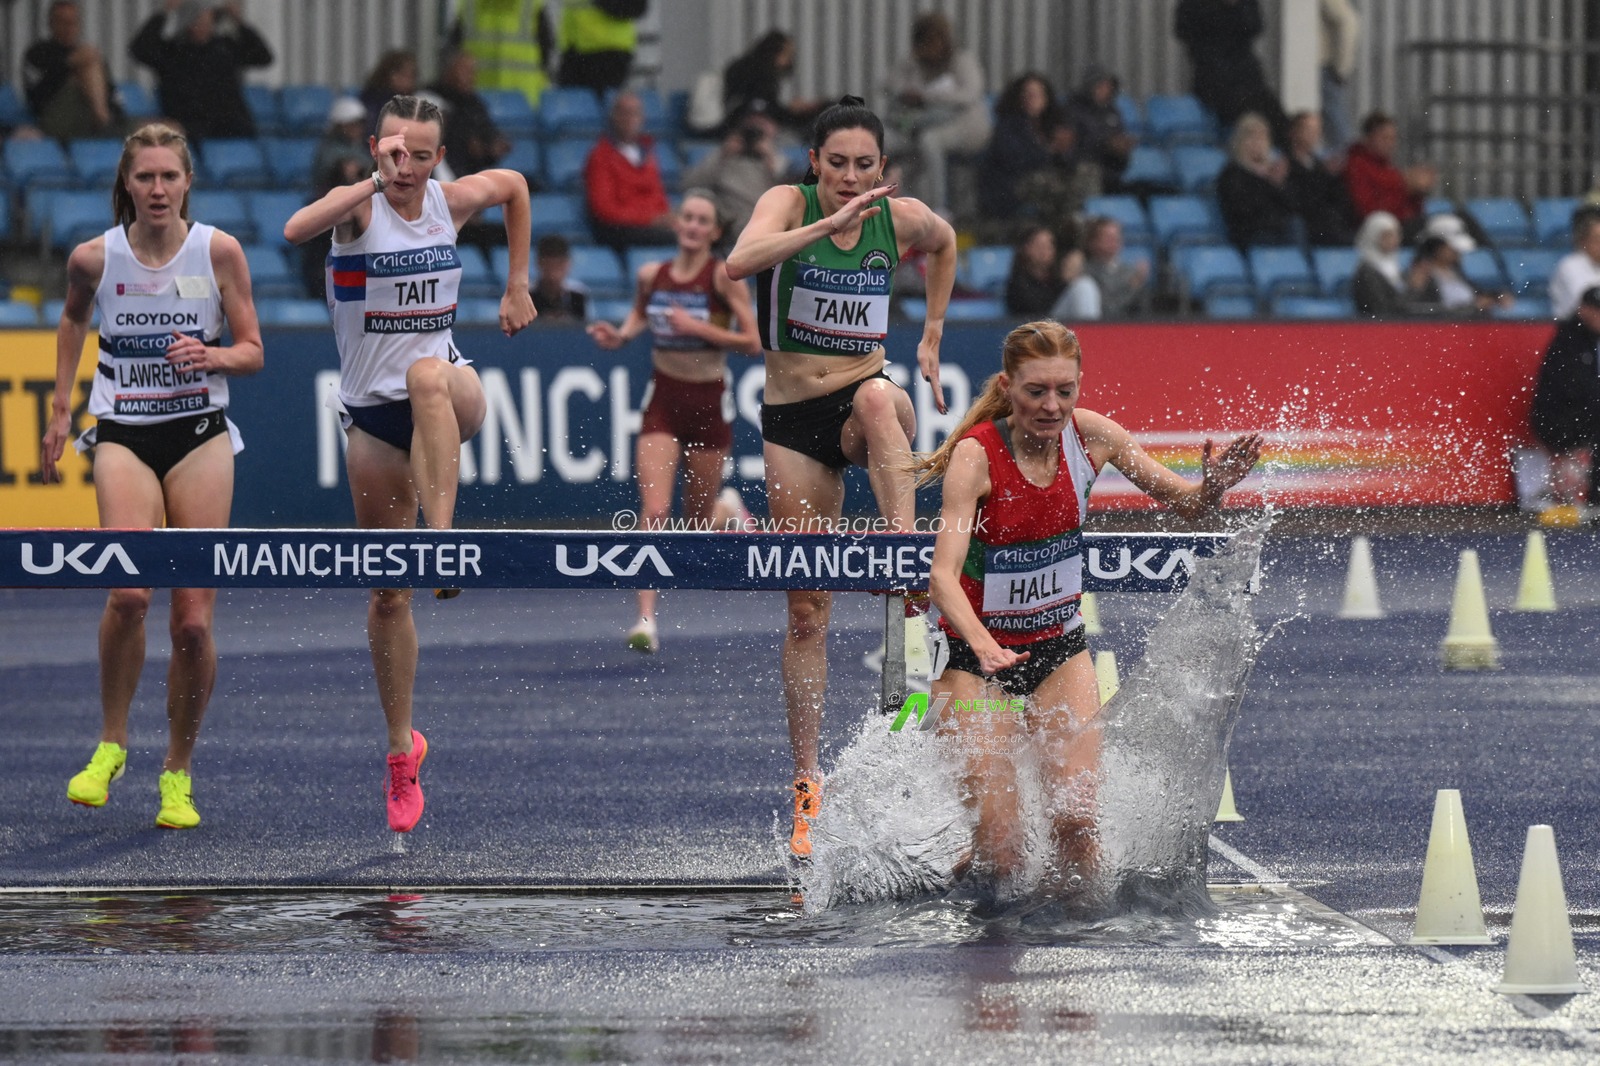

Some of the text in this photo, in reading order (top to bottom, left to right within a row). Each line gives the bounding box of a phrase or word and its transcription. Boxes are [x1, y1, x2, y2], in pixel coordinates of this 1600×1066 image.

[392, 265, 429, 274] PROCESSING
[395, 278, 439, 306] TAIT
[820, 284, 858, 292] PROCESSING
[116, 313, 198, 326] CROYDON
[371, 313, 453, 331] MANCHESTER
[814, 297, 872, 327] TANK
[791, 328, 879, 353] MANCHESTER
[120, 396, 204, 412] MANCHESTER
[21, 542, 140, 575] UKA
[213, 543, 482, 576] MANCHESTER
[555, 544, 674, 577] UKA
[1088, 548, 1196, 580] UKA
[1009, 569, 1063, 605] HALL
[988, 603, 1076, 630] MANCHESTER
